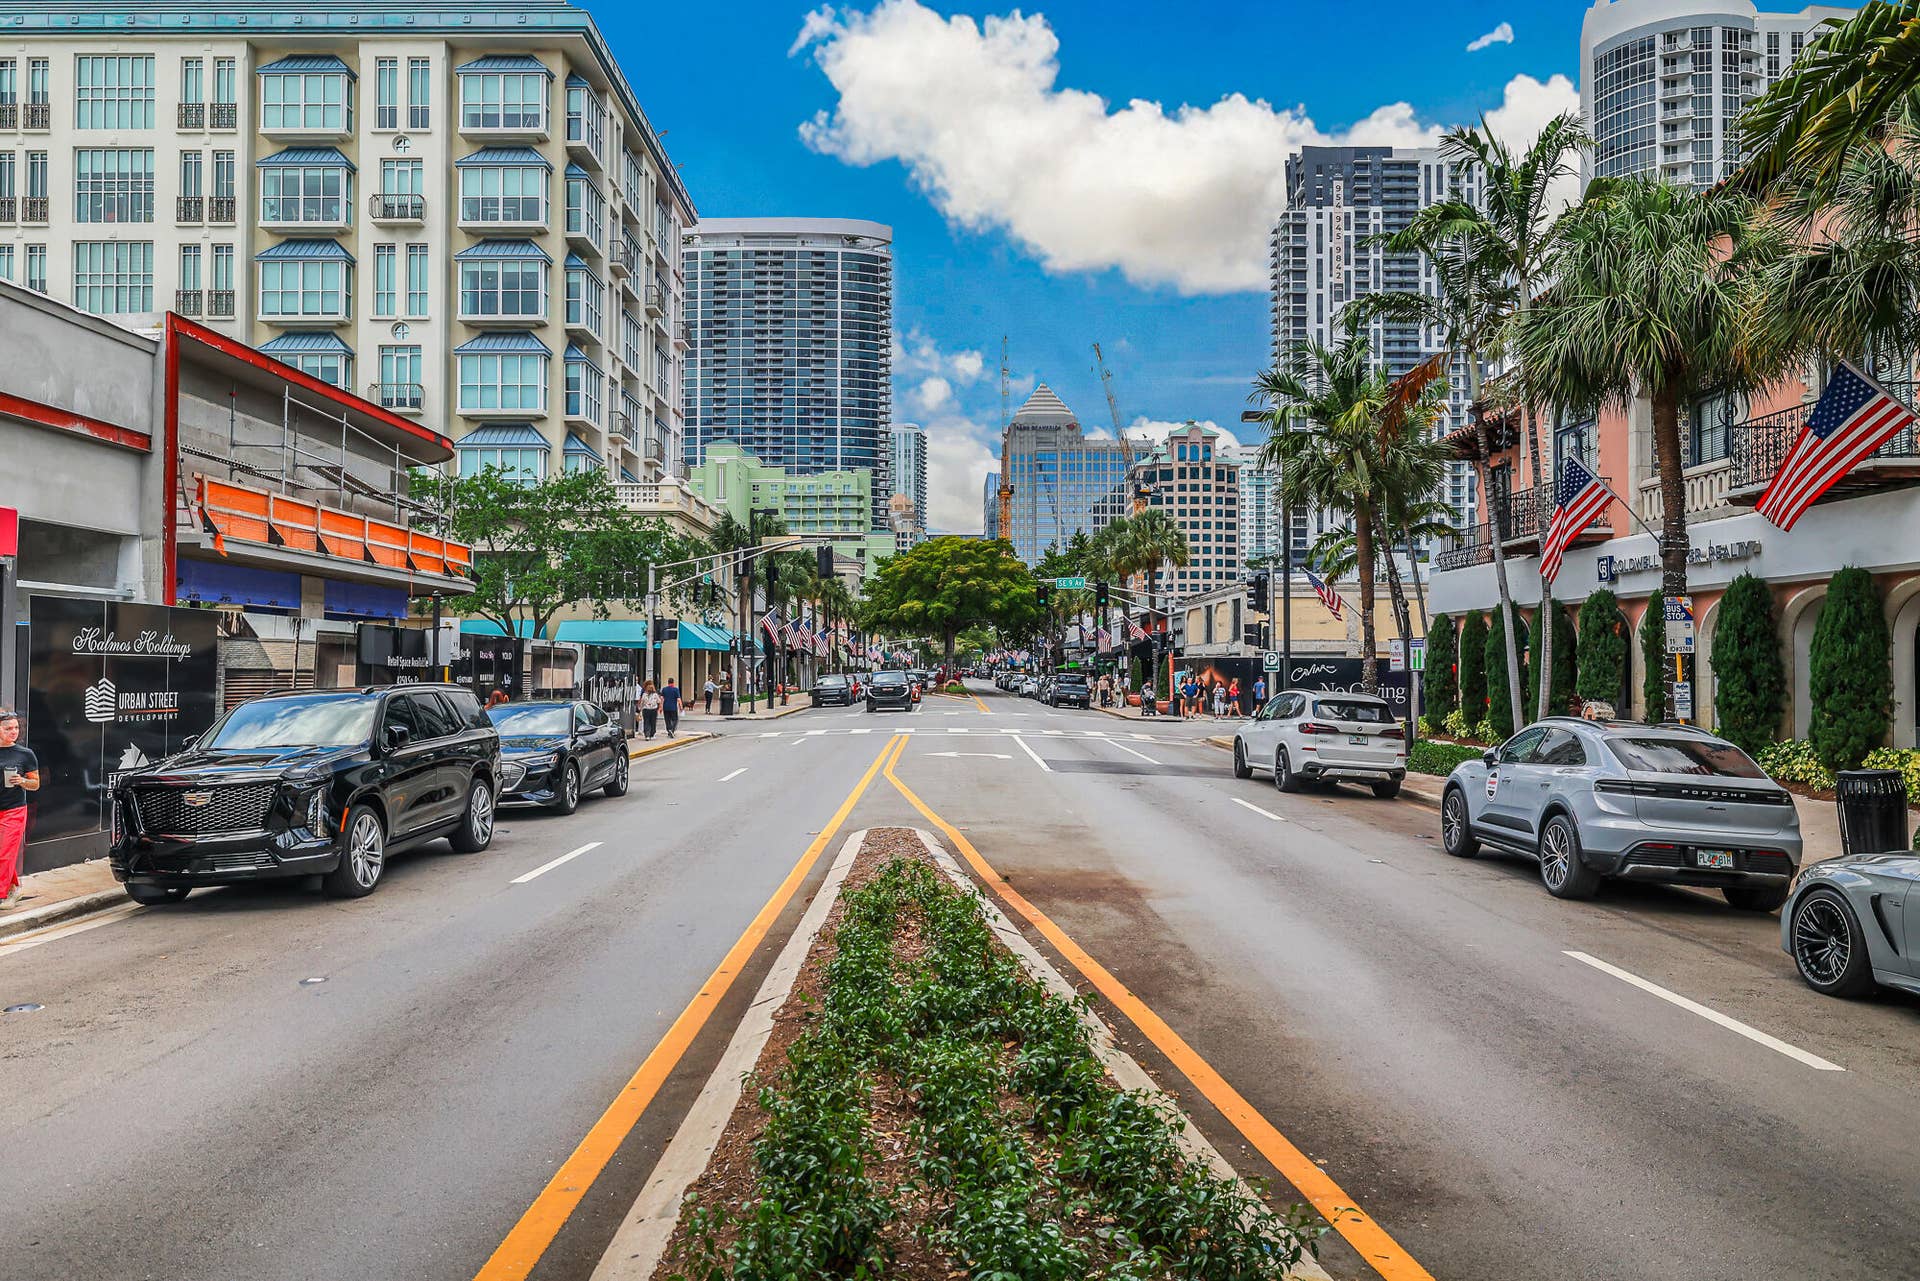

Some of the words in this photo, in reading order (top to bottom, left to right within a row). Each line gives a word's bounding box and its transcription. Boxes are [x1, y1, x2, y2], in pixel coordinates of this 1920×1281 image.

[1611, 554, 1660, 575] COLDWELL
[1708, 540, 1756, 562] REALTY
[1058, 579, 1067, 587] SE
[1068, 579, 1073, 587] 9
[1074, 579, 1083, 587] Av
[1666, 605, 1681, 613] BUS
[73, 627, 131, 653] Halmos
[133, 631, 191, 662] Holdings
[119, 692, 147, 710] URBAN
[148, 692, 179, 709] STREET
[119, 713, 178, 722] DEVELOPMENT
[1681, 789, 1747, 798] PORSCHE
